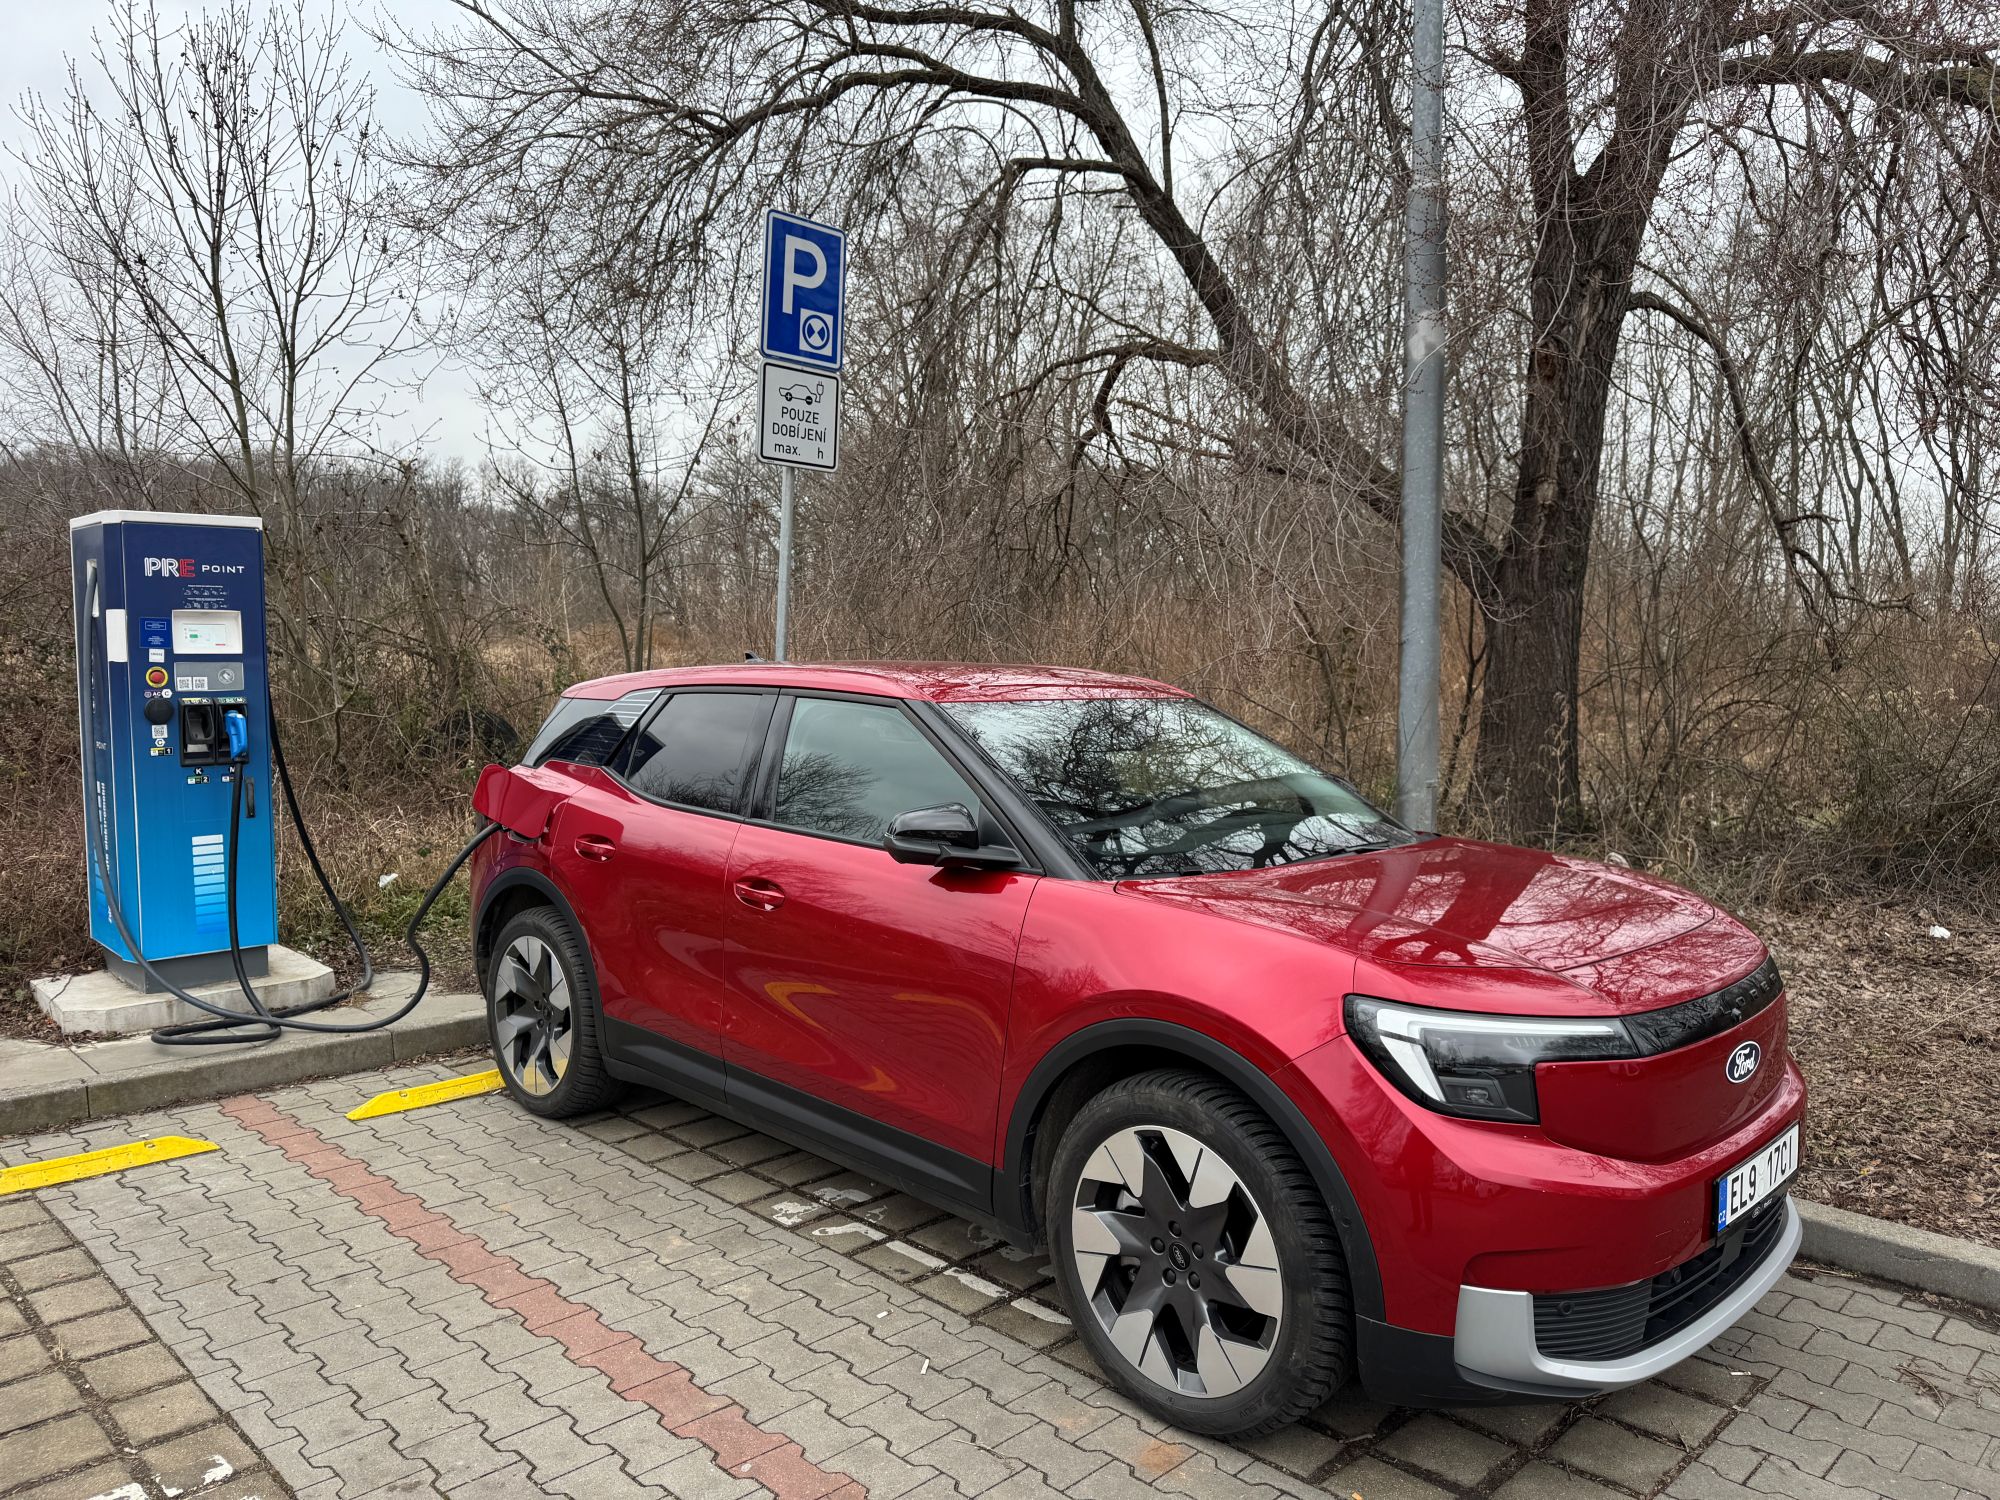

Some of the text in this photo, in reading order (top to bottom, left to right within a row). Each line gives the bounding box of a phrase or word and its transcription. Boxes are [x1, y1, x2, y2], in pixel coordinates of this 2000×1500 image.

[782, 234, 827, 315] P
[781, 406, 820, 425] POUZE
[772, 422, 827, 443] DOBÍJENÍ
[774, 443, 824, 459] max. h
[144, 557, 245, 577] PRE POINT
[1733, 1046, 1756, 1079] Ford
[1731, 1164, 1757, 1216] EL9
[1718, 1209, 1727, 1224] CZ
